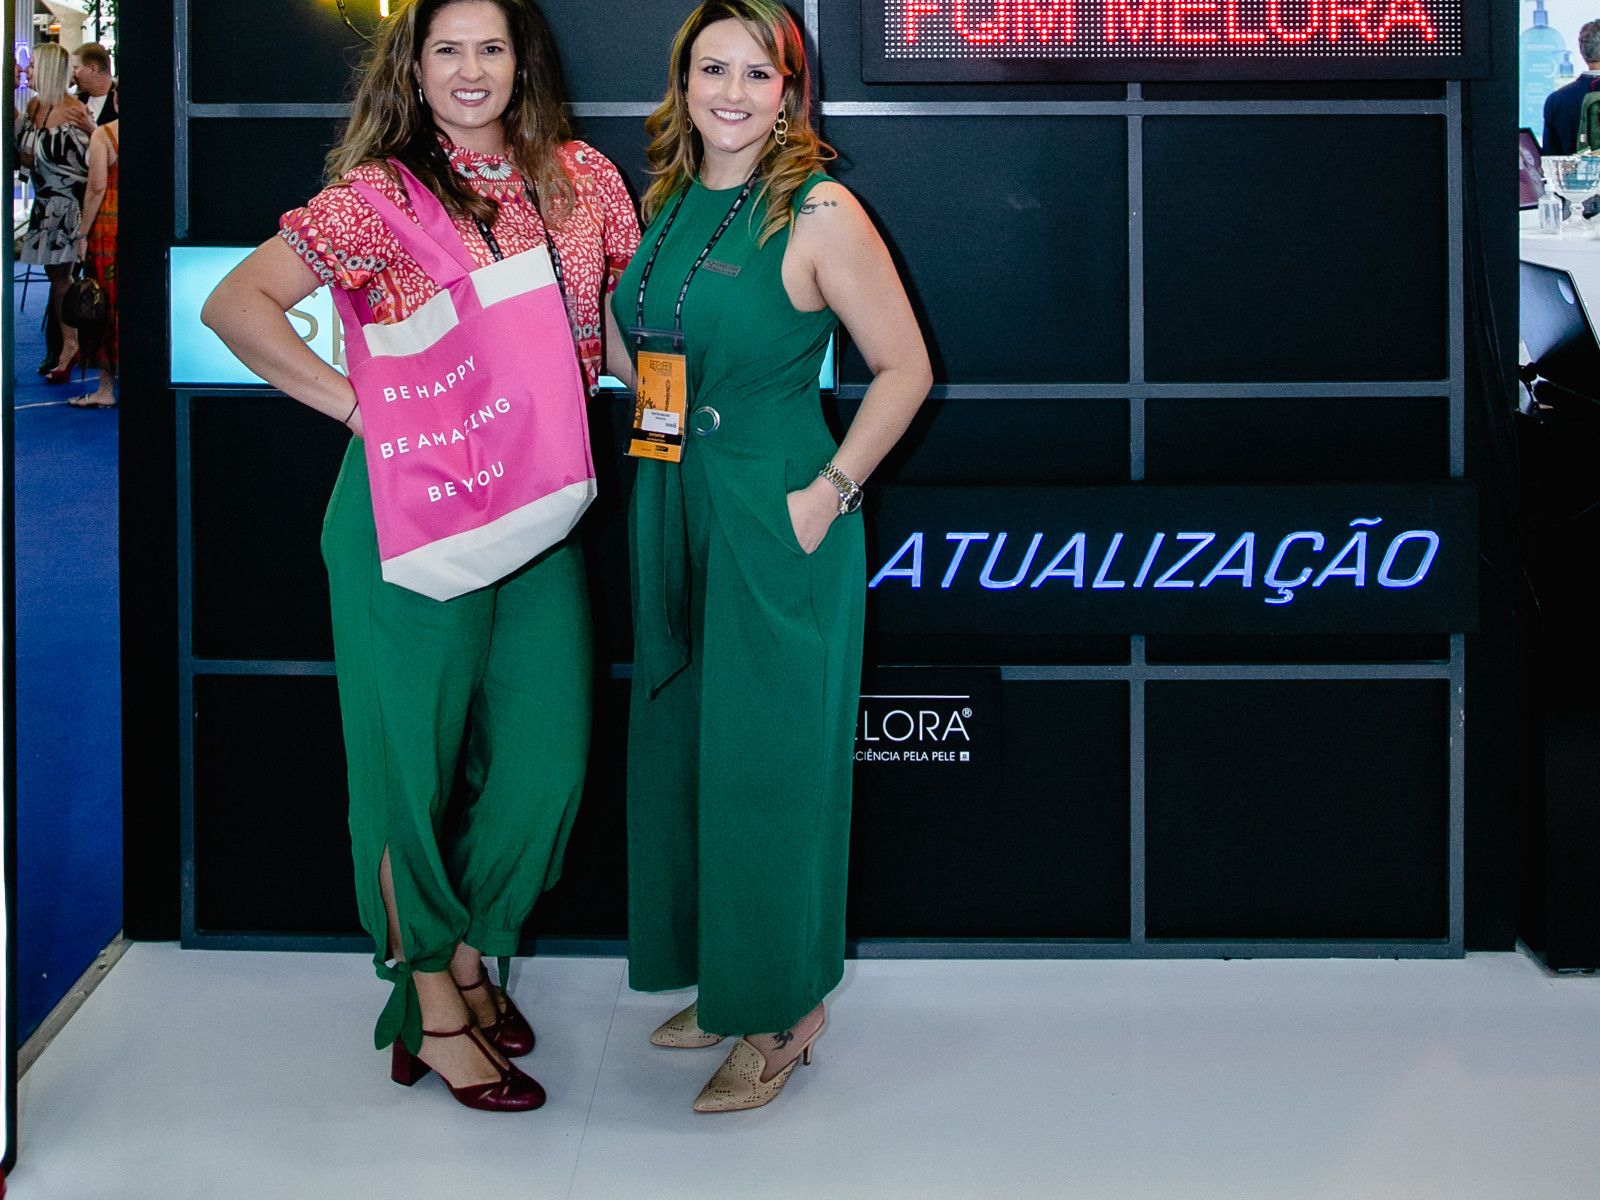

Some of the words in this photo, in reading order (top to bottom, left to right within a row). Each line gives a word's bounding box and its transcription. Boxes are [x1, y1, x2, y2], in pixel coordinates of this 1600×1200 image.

[383, 386, 411, 402] BE
[416, 355, 476, 398] HAPPY
[380, 437, 410, 459] BE
[418, 398, 511, 448] AMAZING
[427, 481, 457, 502] BE
[461, 461, 505, 493] YOU
[868, 515, 1440, 605] ATUALIZAÇÃO
[854, 707, 972, 741] LORA®
[903, 751, 929, 761] PELA
[932, 751, 955, 761] PELE
